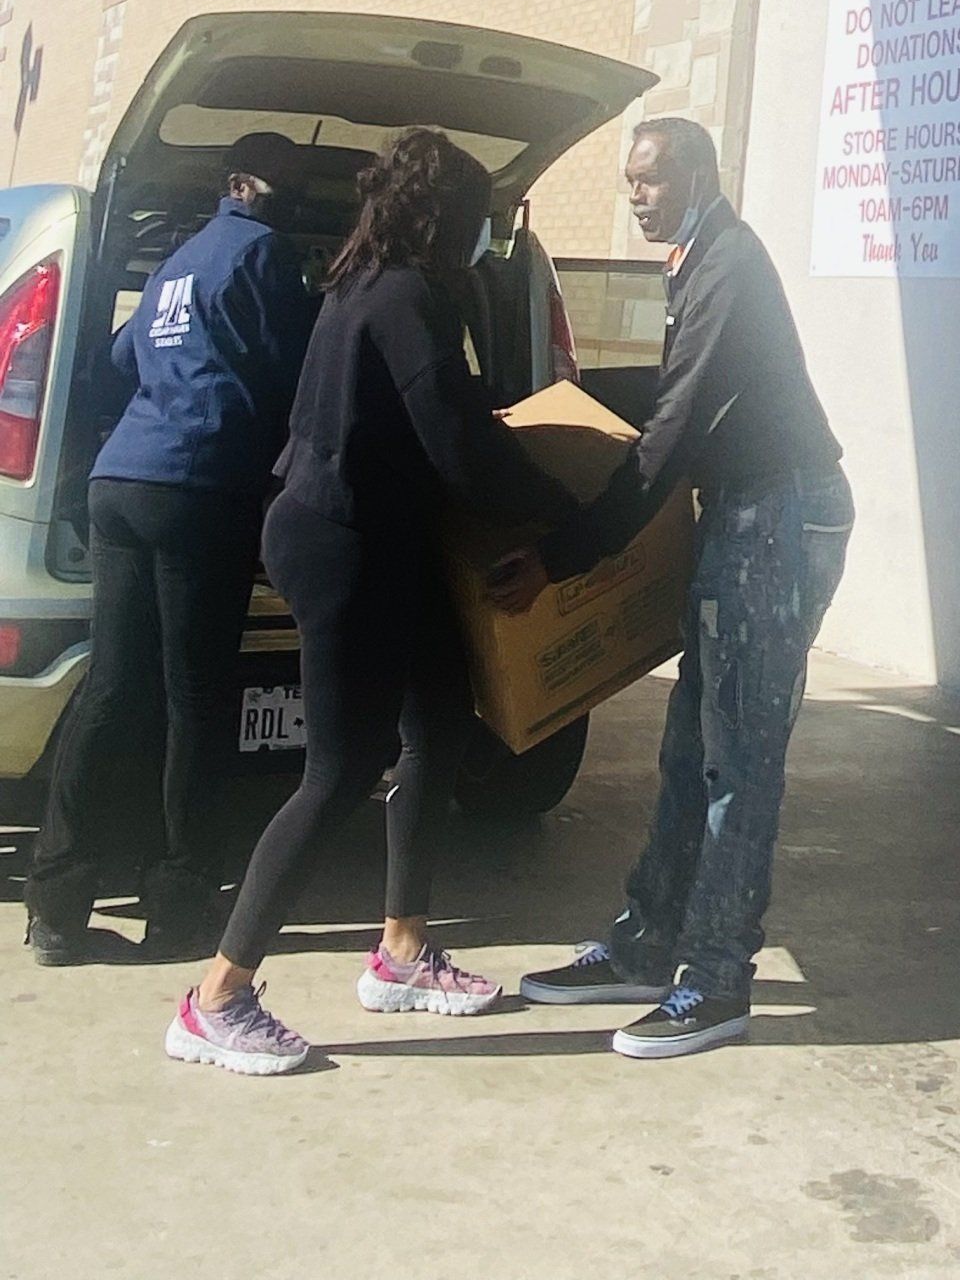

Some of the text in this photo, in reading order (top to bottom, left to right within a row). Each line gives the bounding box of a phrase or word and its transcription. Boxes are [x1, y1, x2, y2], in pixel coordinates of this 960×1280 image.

[845, 7, 872, 35] DO
[830, 77, 900, 117] AFTER
[842, 128, 898, 156] STORE
[858, 195, 949, 223] 10AM-6PM
[862, 232, 939, 263] Thank You
